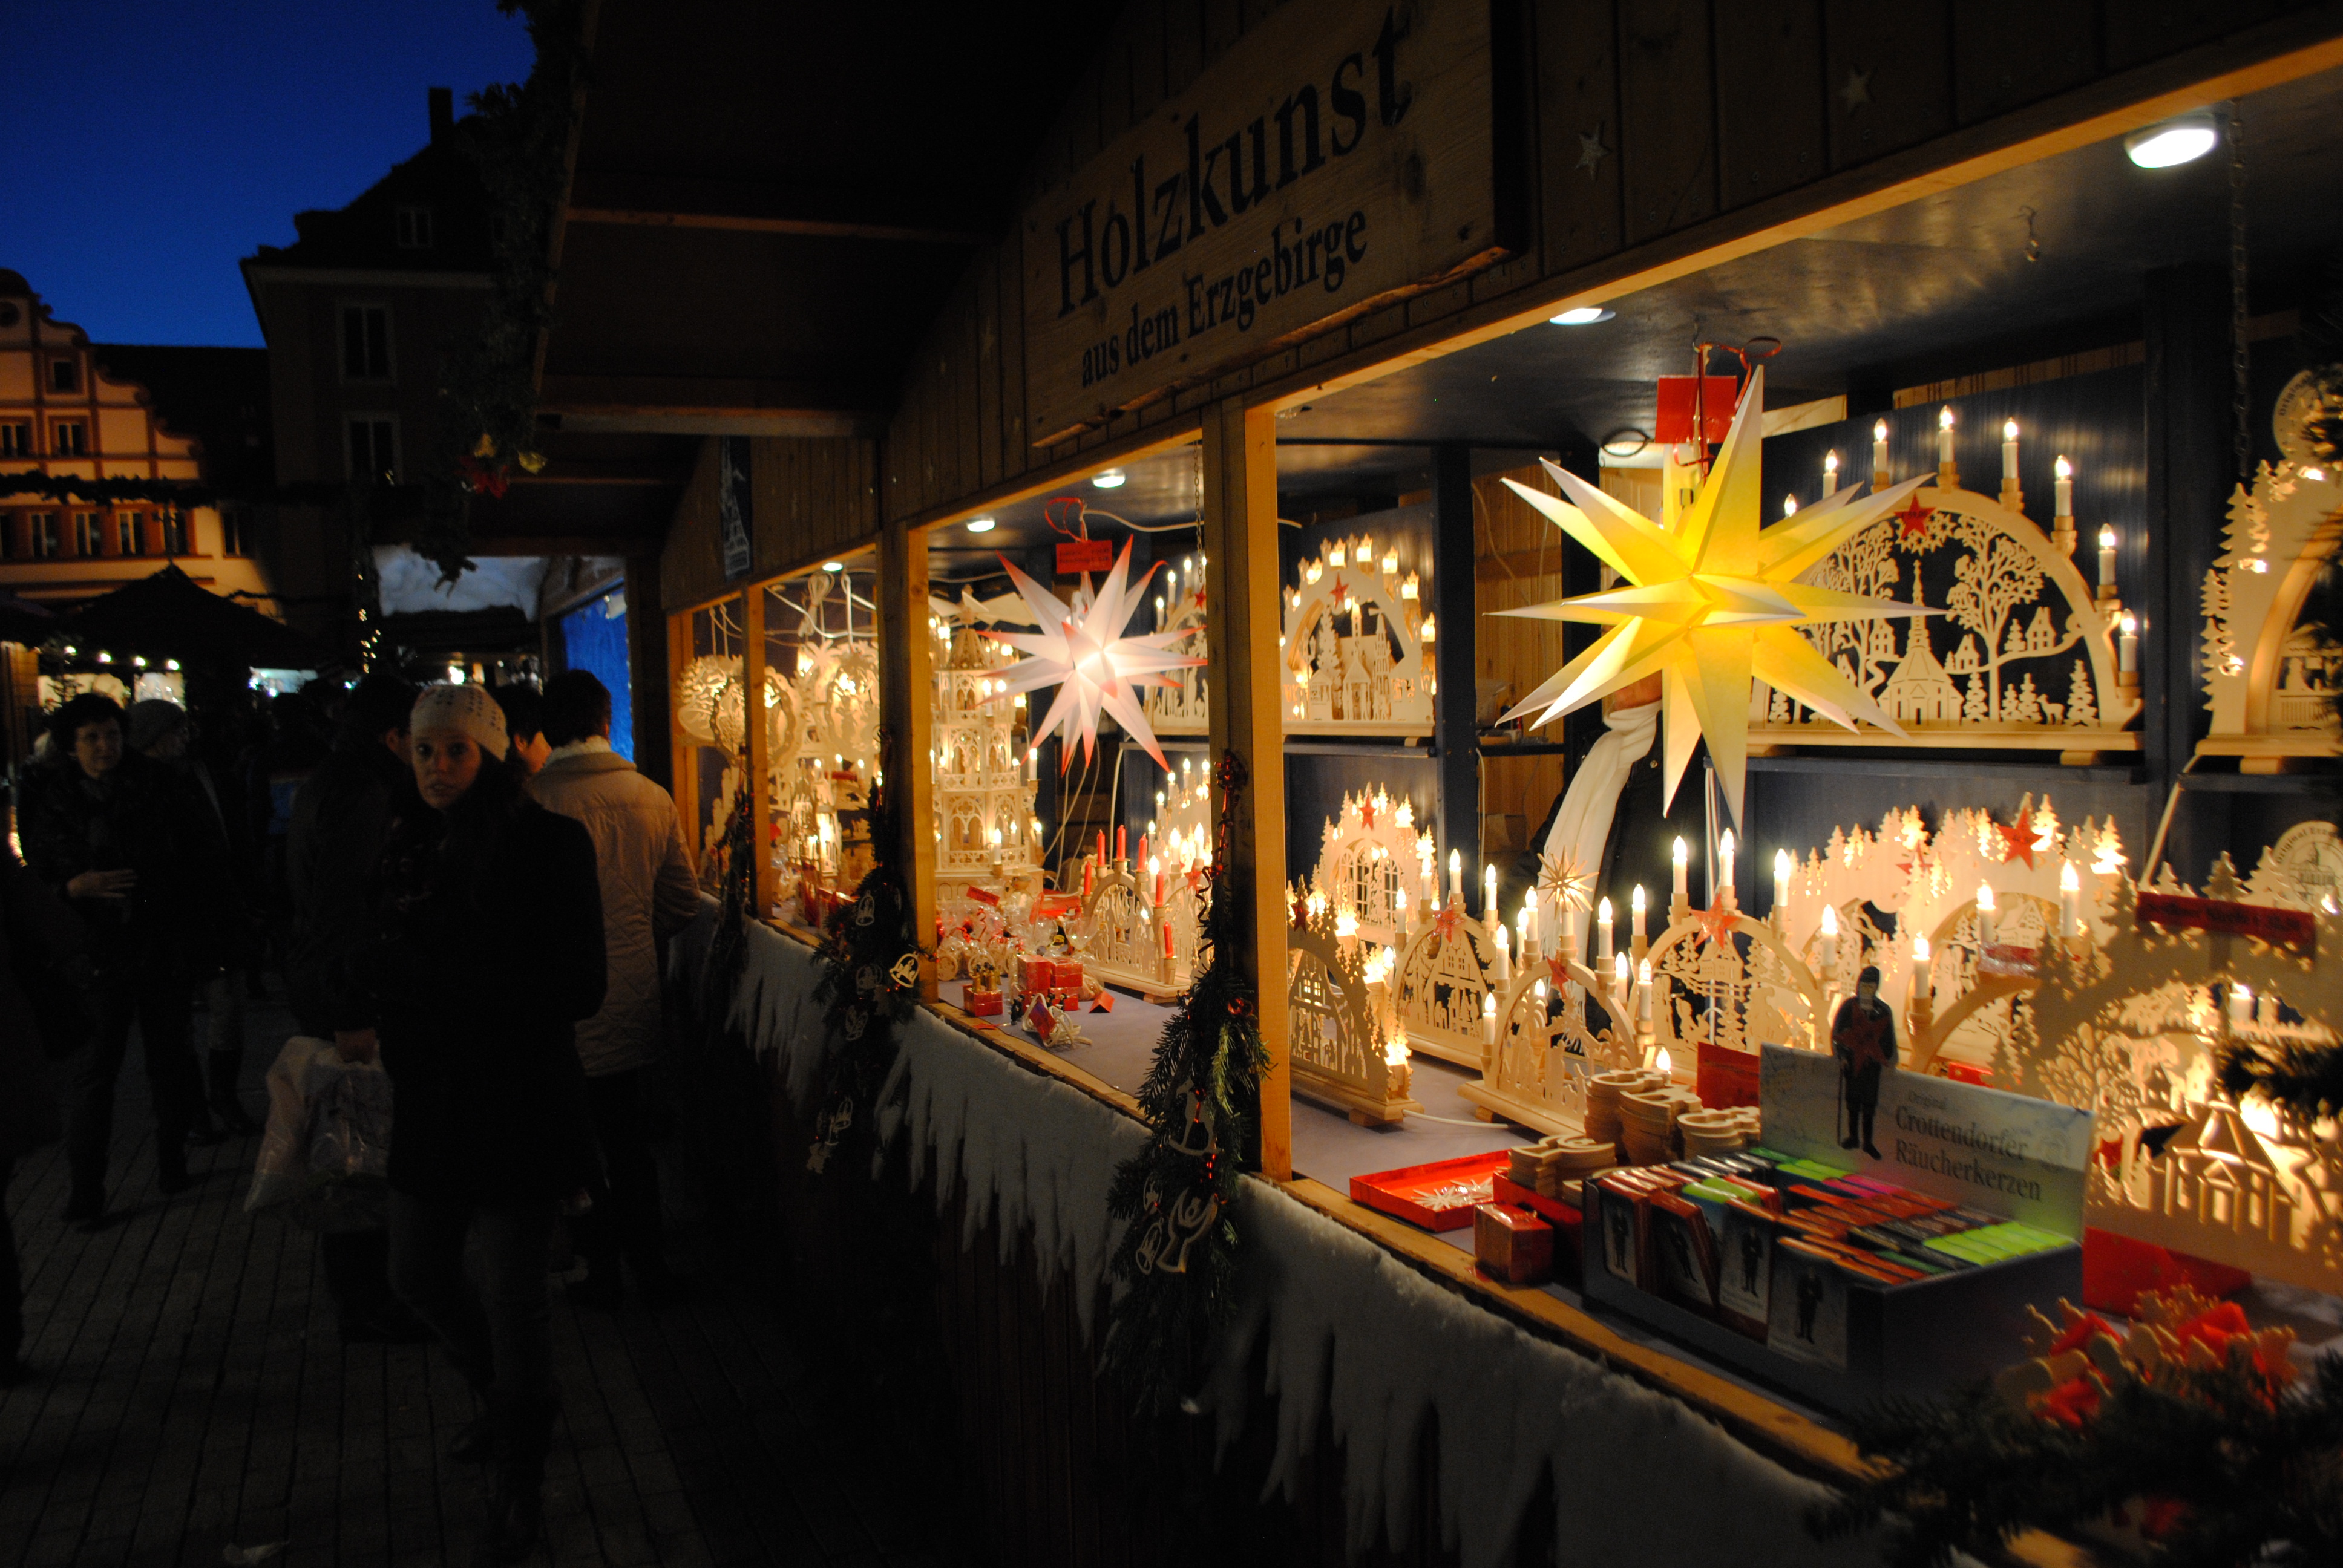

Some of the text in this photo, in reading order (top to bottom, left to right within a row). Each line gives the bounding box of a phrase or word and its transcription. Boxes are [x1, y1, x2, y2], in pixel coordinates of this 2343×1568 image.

[1055, 5, 1414, 318] Holzkunst
[1081, 209, 1368, 388] aus dem Erzgebirge
[1895, 1106, 2028, 1161] Crottendorfer
[1895, 1138, 2041, 1201] Räucherkerzen
